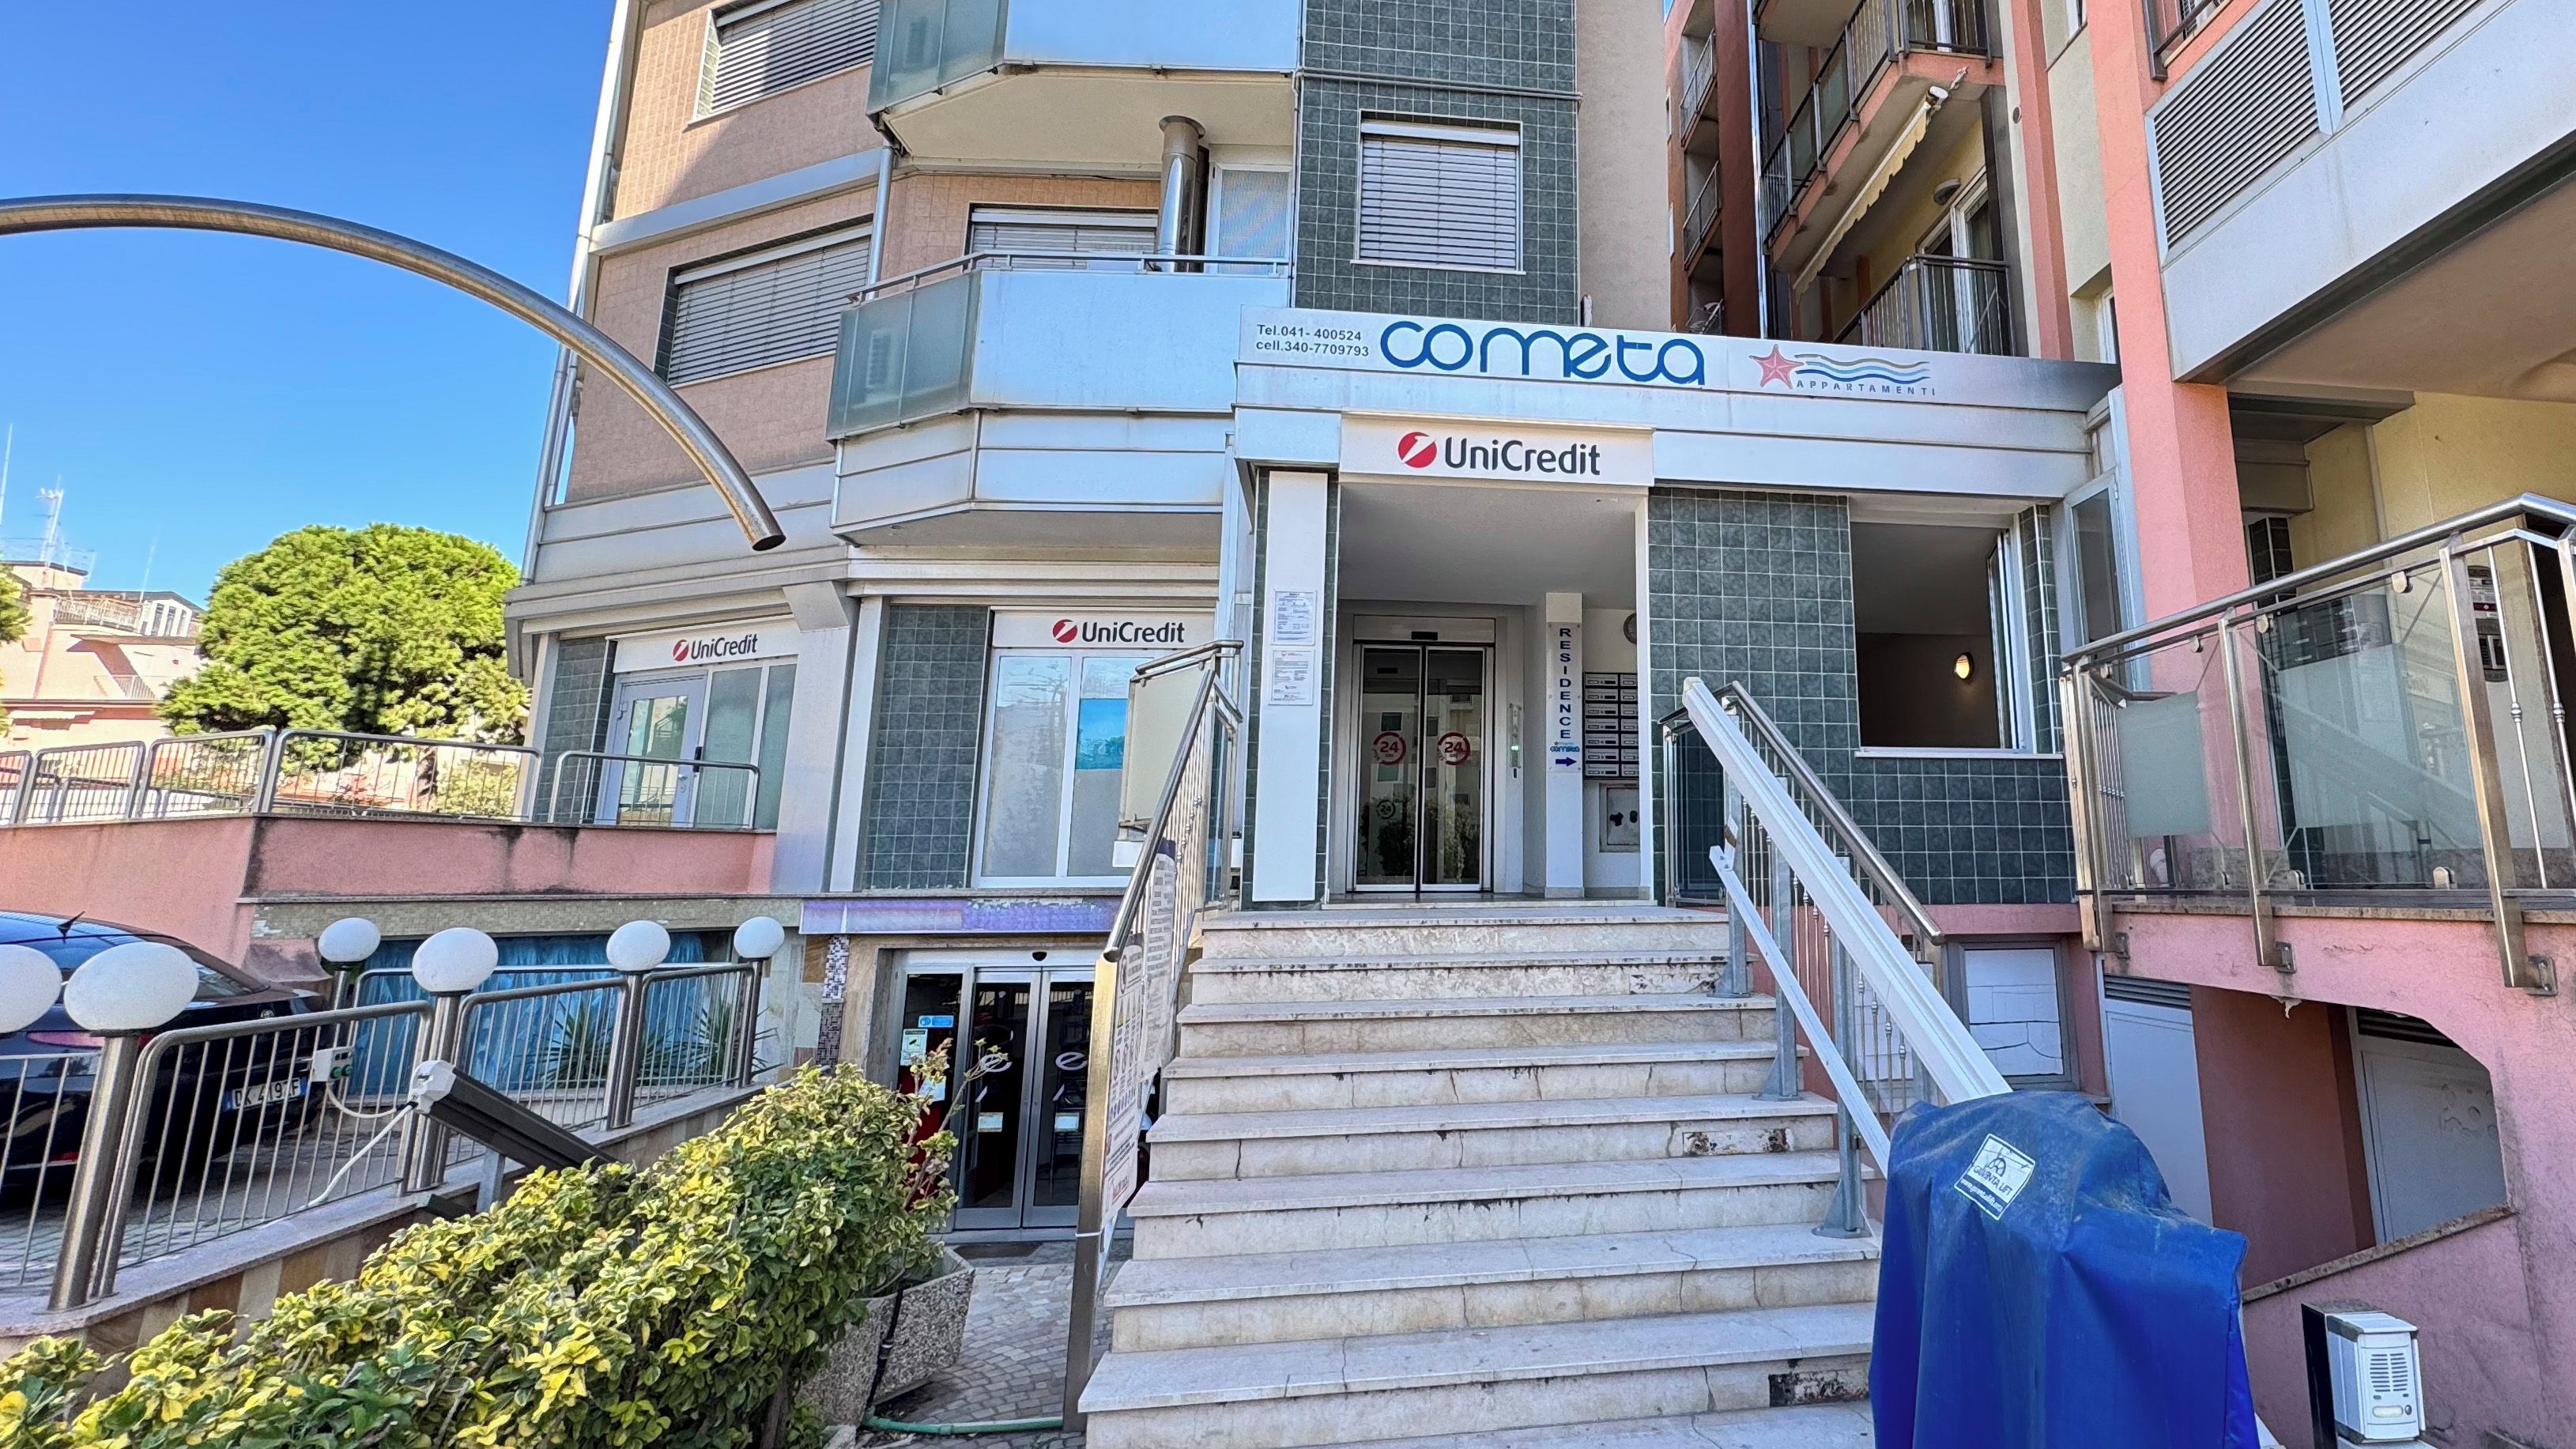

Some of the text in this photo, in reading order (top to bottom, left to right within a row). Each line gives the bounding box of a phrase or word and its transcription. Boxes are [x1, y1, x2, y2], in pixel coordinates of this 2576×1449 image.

[1314, 328, 1361, 341] 400524
[1256, 340, 1369, 357] cell.340-7709793
[1379, 320, 1706, 386] cometa
[1796, 379, 1936, 396] APPARTAMENTI
[1445, 436, 1601, 475] UniCredit
[1082, 621, 1185, 643] UniCredit
[691, 633, 759, 660] UniCredit
[1559, 628, 1572, 739] RESIDENCE
[1379, 741, 1399, 753] 24
[1444, 741, 1465, 753] 24
